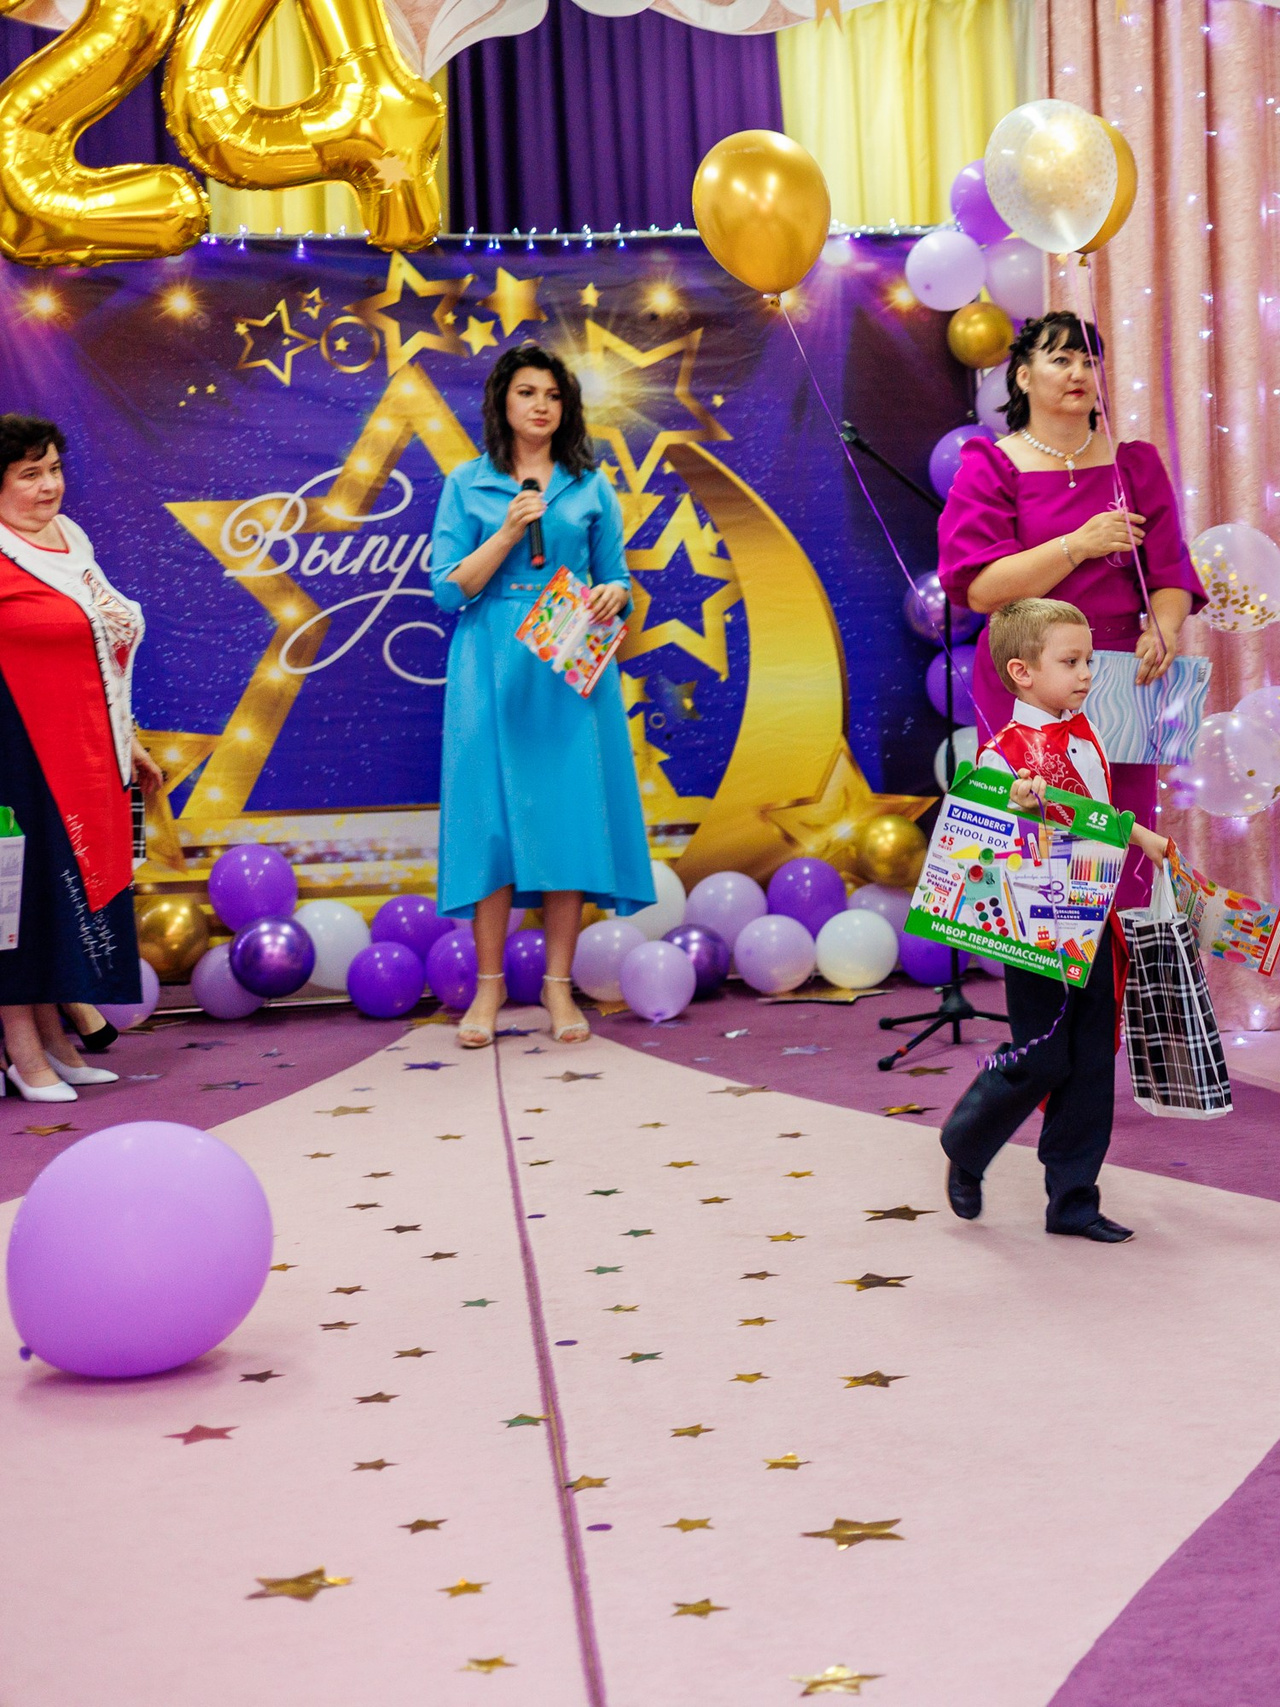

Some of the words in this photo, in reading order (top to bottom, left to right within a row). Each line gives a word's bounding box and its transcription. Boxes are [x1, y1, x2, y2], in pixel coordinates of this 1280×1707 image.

[961, 811, 1006, 832] BRAUBERG
[1088, 811, 1109, 827] 45
[940, 834, 955, 847] 45
[943, 822, 984, 842] SCHOOL
[987, 836, 1009, 849] BOX
[931, 921, 967, 939] НАБОР
[968, 933, 1062, 969] ПЕРВОКЛАССНИКА
[1068, 966, 1081, 976] 45
